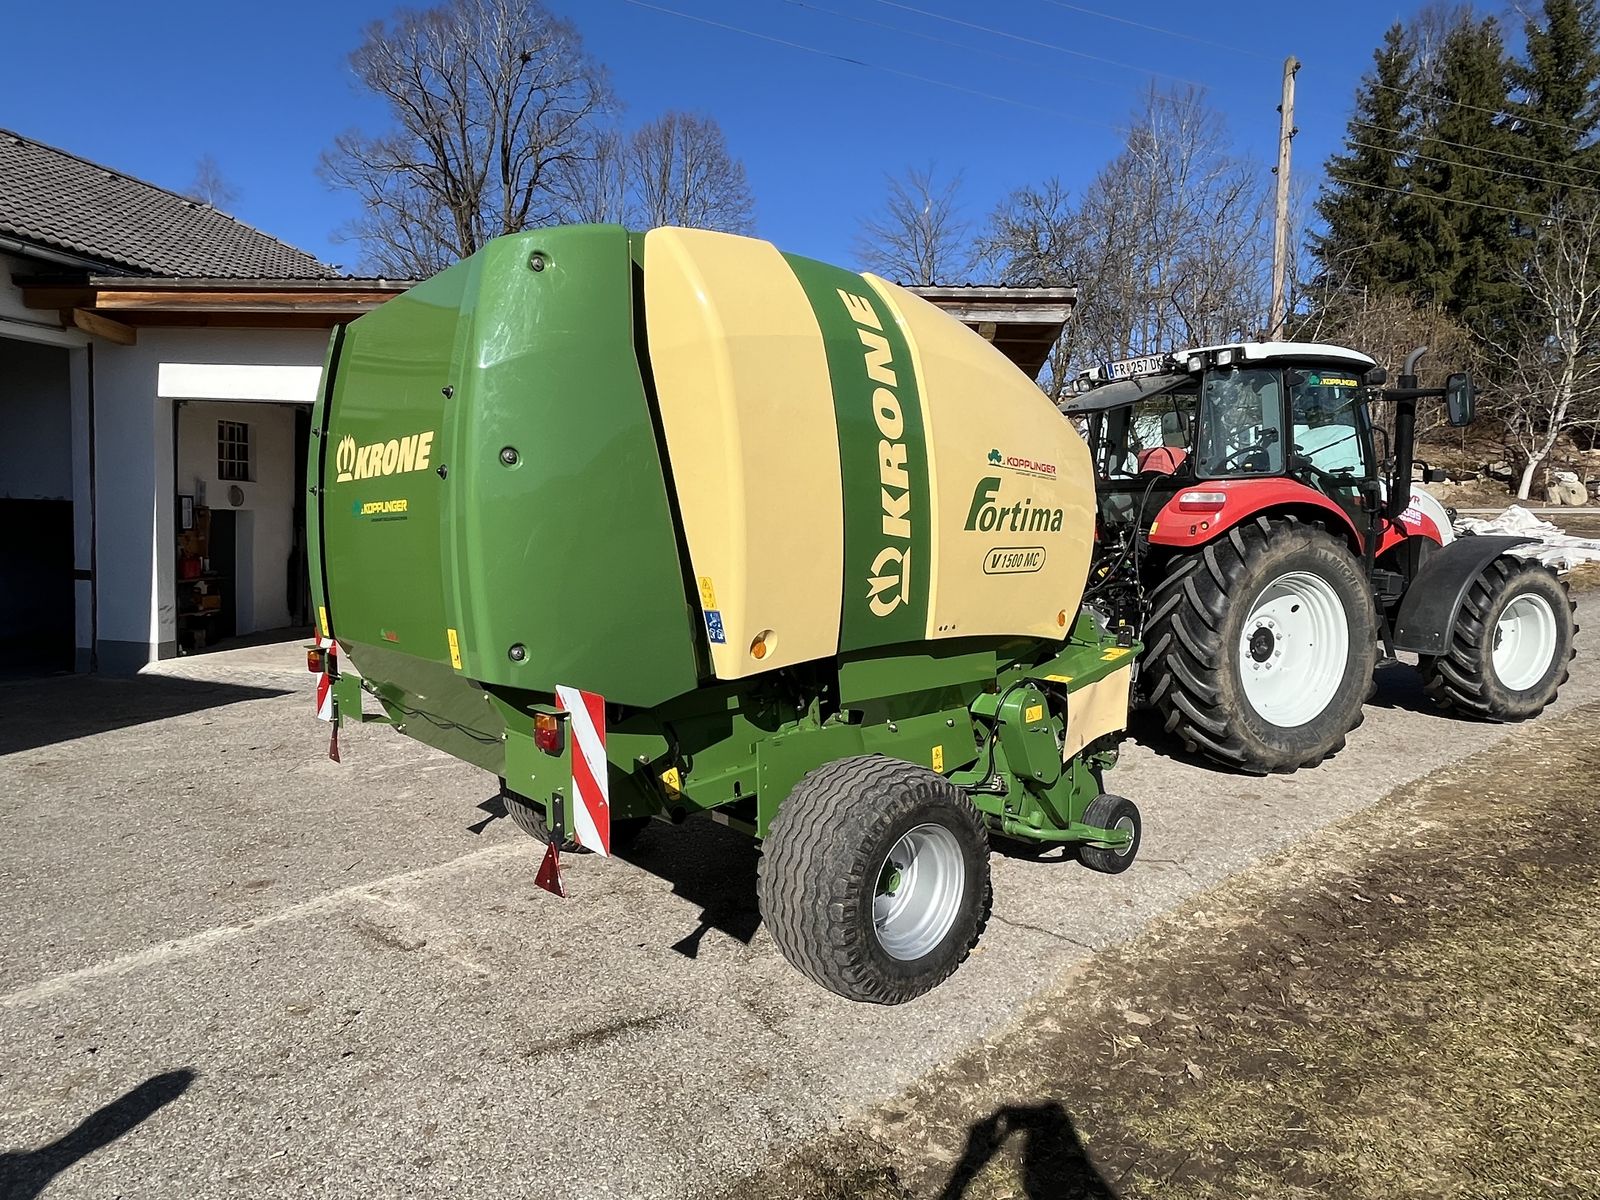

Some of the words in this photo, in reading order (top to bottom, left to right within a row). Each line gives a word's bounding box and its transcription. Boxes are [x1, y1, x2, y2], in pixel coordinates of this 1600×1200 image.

[1114, 364, 1126, 376] FR
[1131, 360, 1148, 374] 257
[837, 288, 911, 538] KRONE
[354, 431, 434, 480] KRONE
[963, 477, 1063, 532] Fortima
[991, 554, 1002, 568] V
[1002, 554, 1024, 568] 1500
[1024, 552, 1040, 567] MC
